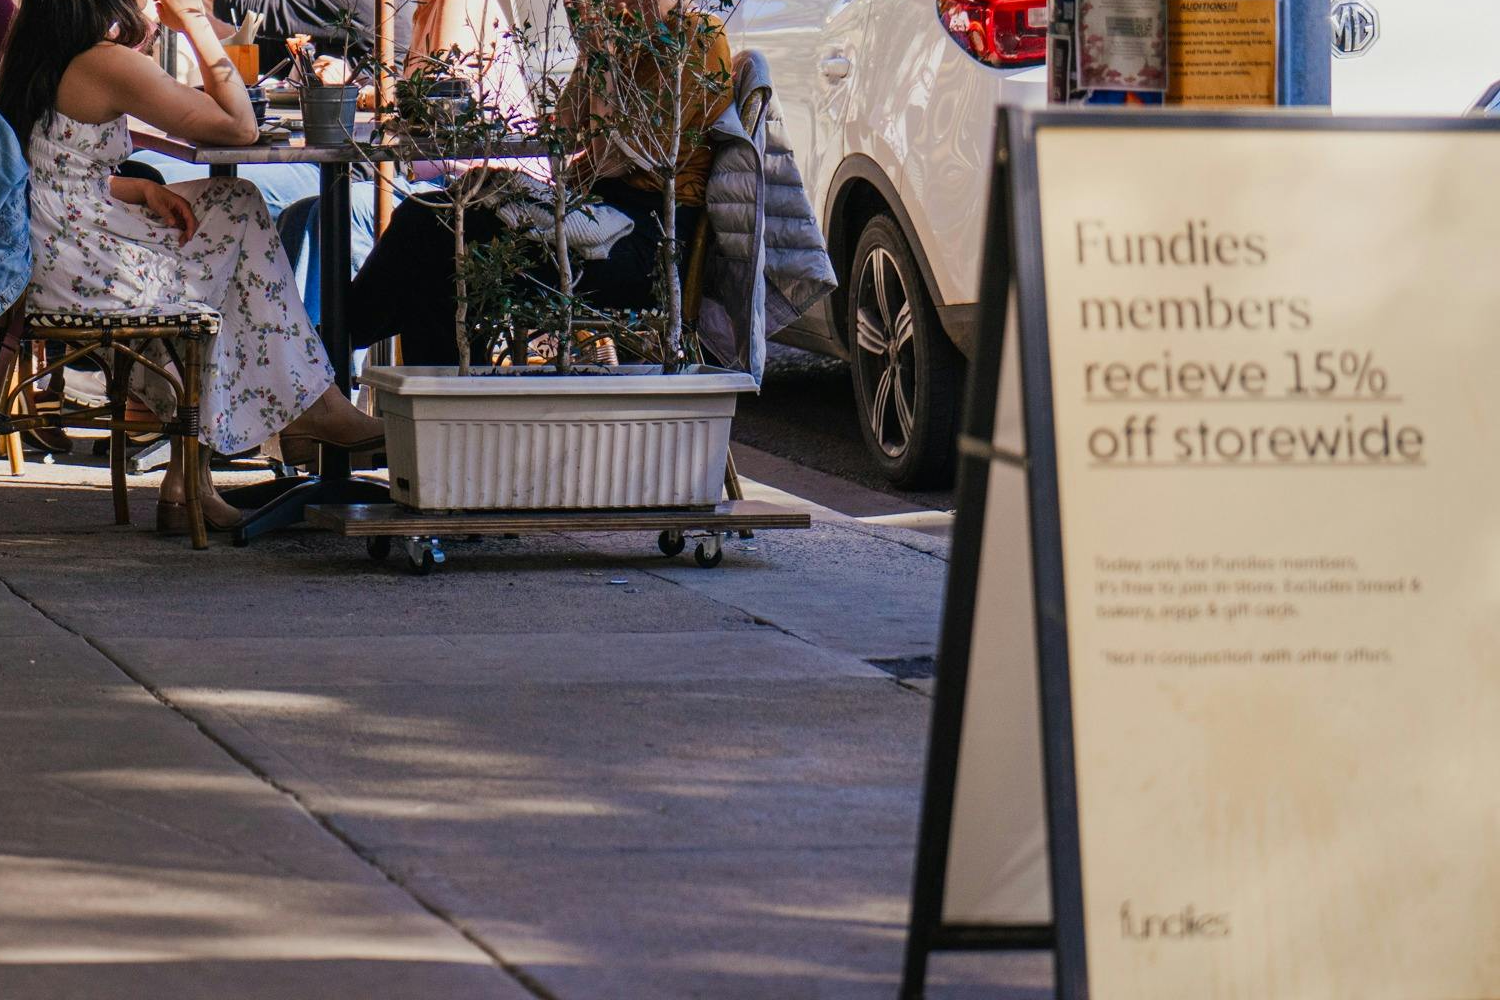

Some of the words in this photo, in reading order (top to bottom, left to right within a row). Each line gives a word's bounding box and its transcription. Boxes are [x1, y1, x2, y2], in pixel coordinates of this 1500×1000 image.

[1180, 2, 1238, 11] AUDITIONS!!!
[1331, 4, 1374, 52] MG
[1075, 221, 1267, 266] Fundies
[1080, 286, 1311, 330] members
[1084, 351, 1267, 396] recieve
[1285, 350, 1388, 397] 15%
[1087, 415, 1156, 463] off
[1174, 415, 1424, 463] storewide
